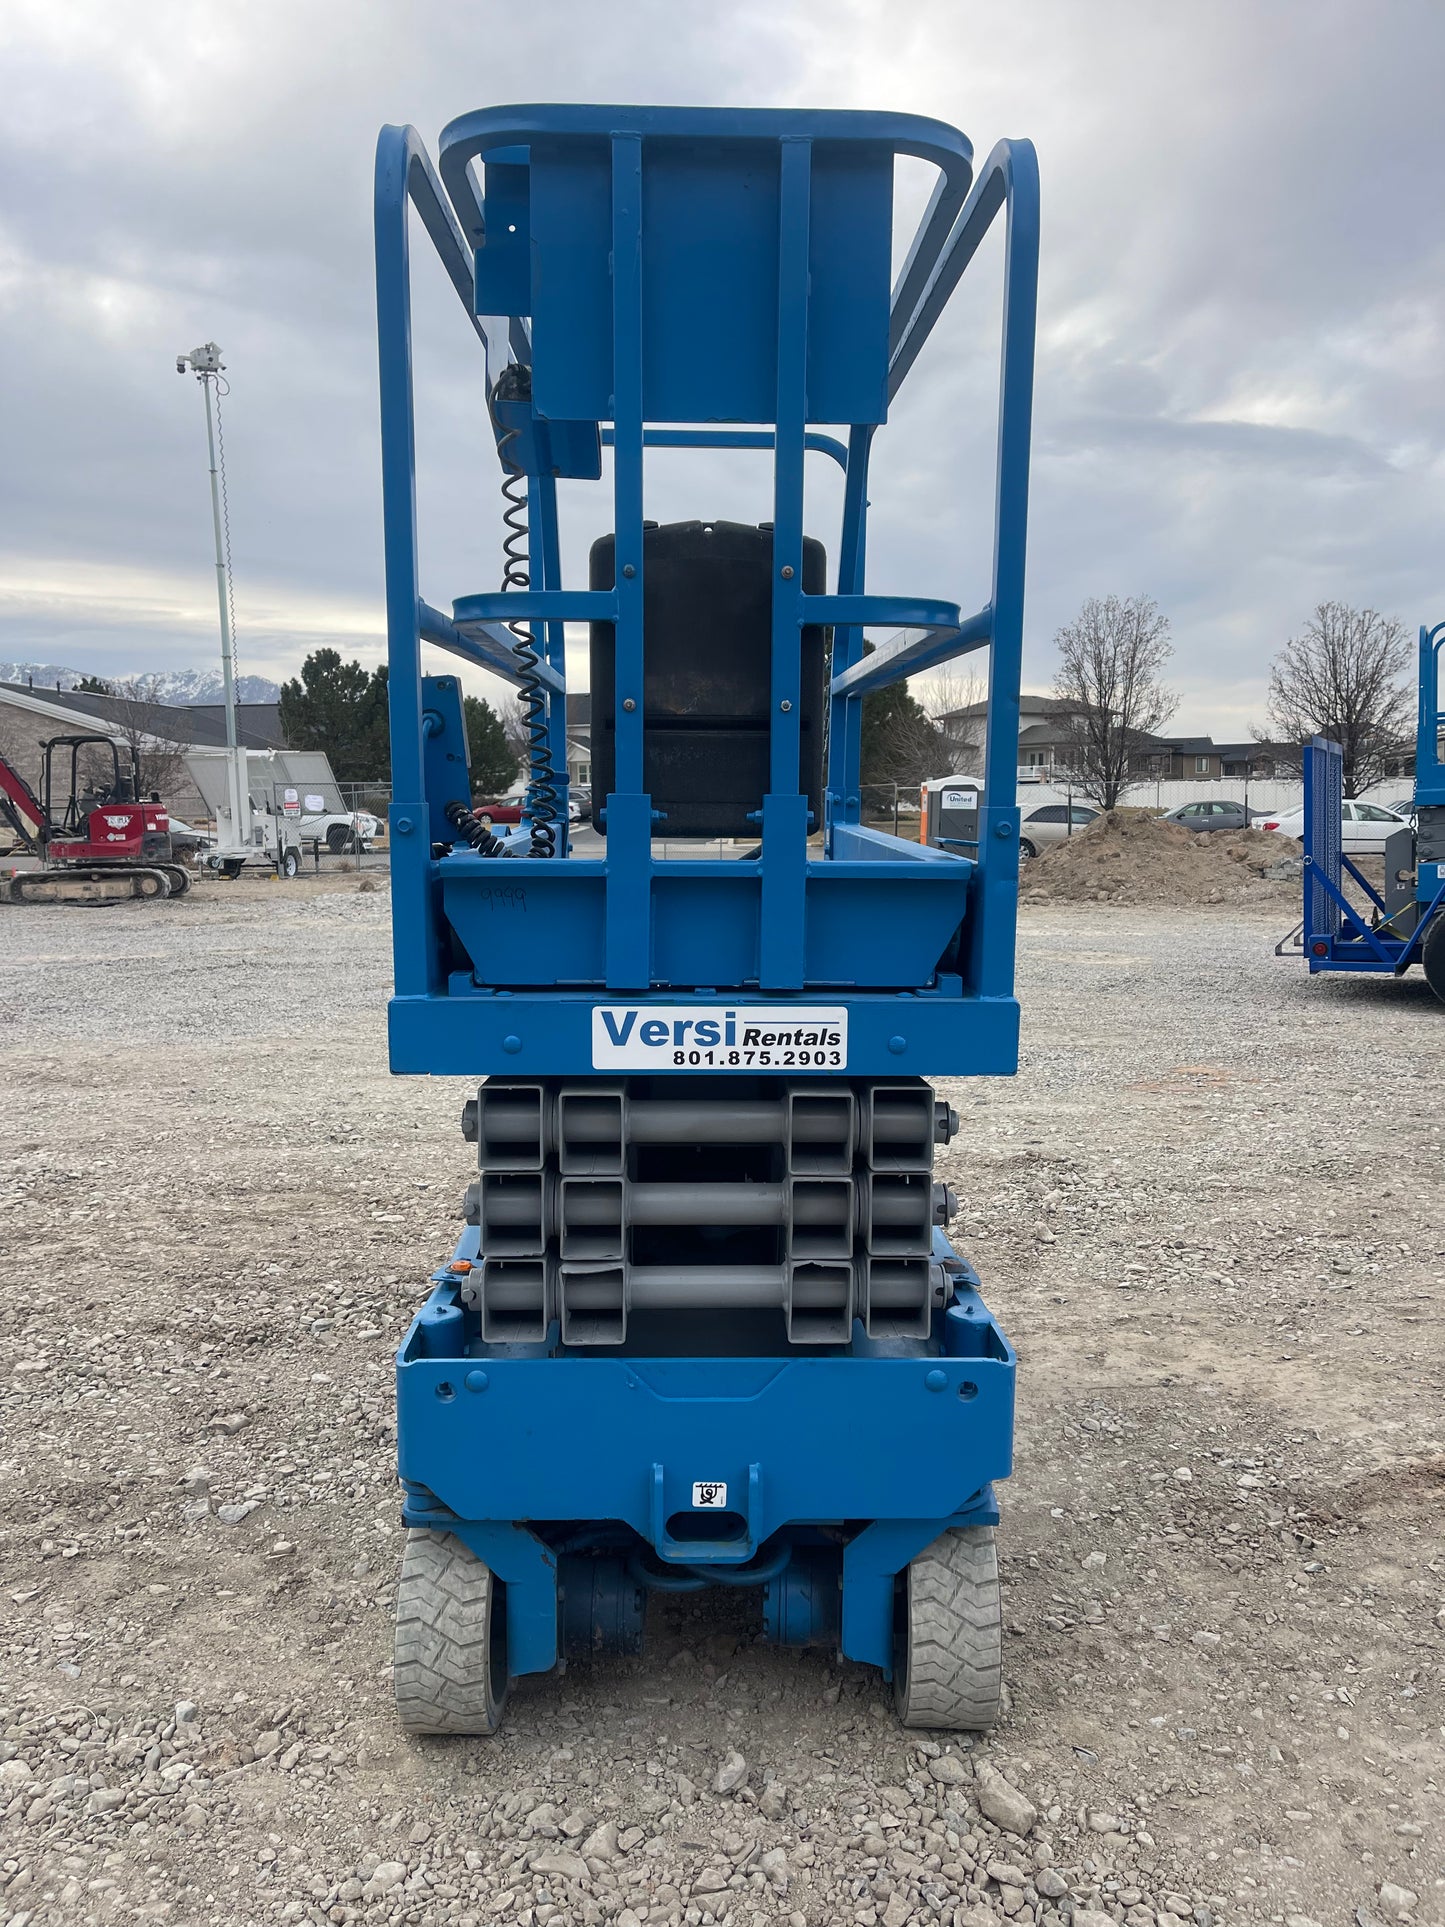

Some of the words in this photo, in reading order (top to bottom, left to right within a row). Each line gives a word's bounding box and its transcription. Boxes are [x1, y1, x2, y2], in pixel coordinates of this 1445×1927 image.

[600, 1011, 736, 1047] Versi
[742, 1028, 841, 1046] Rentals
[673, 1050, 841, 1065] 801.875.2903
